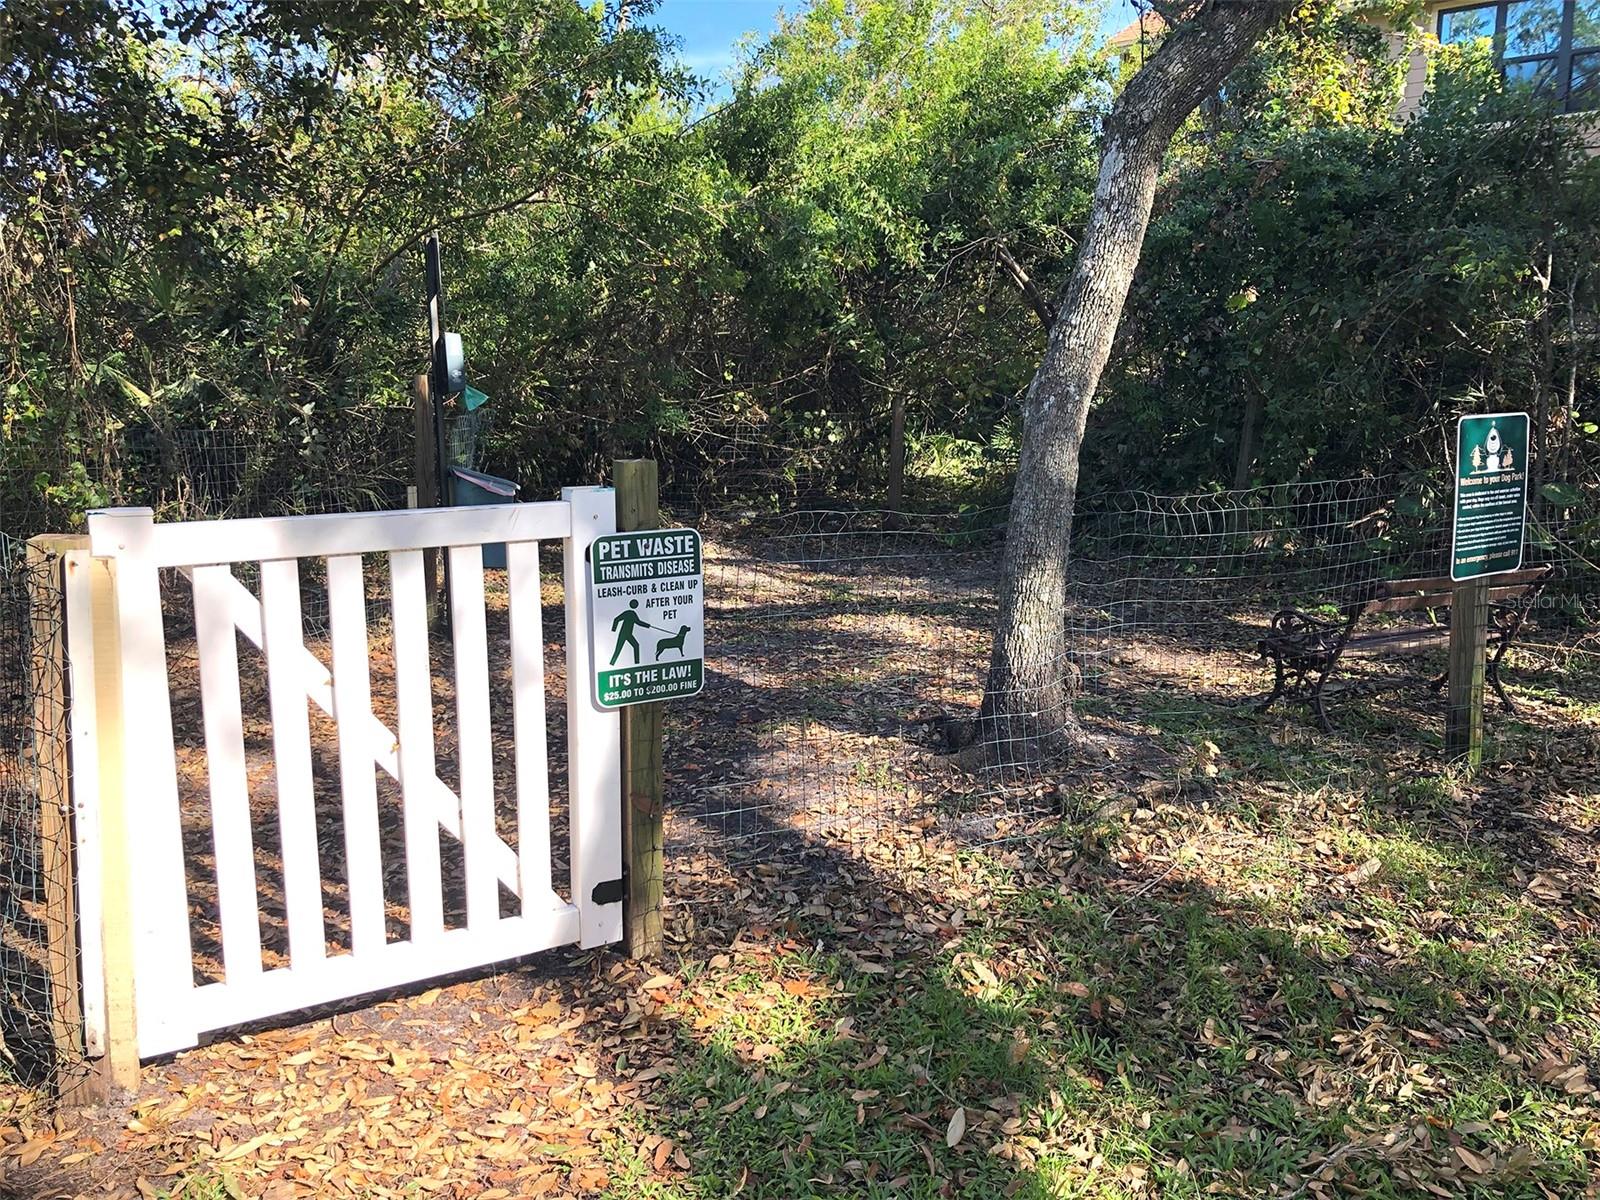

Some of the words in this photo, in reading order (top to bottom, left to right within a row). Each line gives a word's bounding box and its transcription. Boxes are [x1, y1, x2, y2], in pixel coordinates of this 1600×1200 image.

[1460, 477, 1482, 486] Welcome
[1483, 476, 1489, 484] to
[1490, 475, 1500, 485] your
[1501, 473, 1511, 483] Dog
[1511, 471, 1524, 481] Park!
[598, 540, 631, 560] PET
[636, 535, 694, 557] WASTE
[1489, 551, 1503, 560] please
[1503, 549, 1511, 557] call
[600, 563, 654, 580] TRANSMITS
[657, 559, 695, 575] DISEASE
[597, 584, 648, 598] LEASH-CURB
[651, 583, 657, 593] &
[660, 580, 685, 592] CLEAN
[687, 579, 698, 589] UP
[645, 596, 670, 608] AFTER
[672, 594, 693, 605] YOUR
[663, 609, 677, 620] PET
[609, 673, 632, 688] IT'S
[634, 669, 658, 684] THE
[662, 665, 692, 681] LAW!
[603, 689, 632, 702] $25.00
[634, 687, 644, 696] TO
[646, 683, 678, 696] $200.00
[680, 680, 698, 691] FINE
